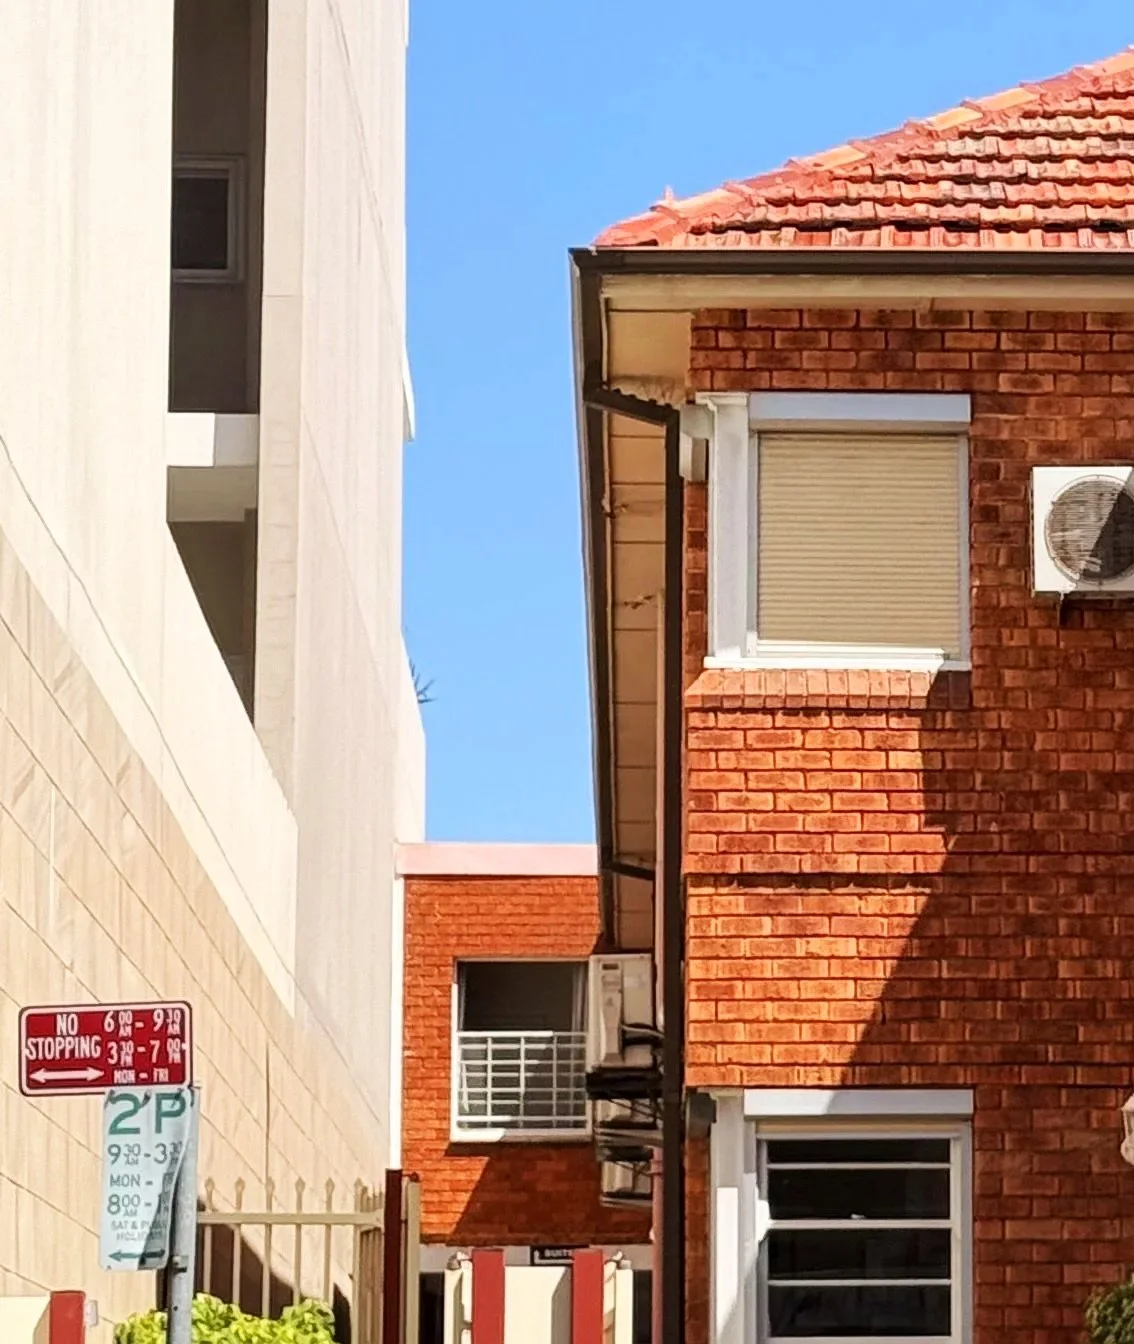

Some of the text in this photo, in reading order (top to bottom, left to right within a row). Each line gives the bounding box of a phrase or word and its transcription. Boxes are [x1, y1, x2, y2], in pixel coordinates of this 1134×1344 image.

[56, 1014, 78, 1036] NO
[27, 1035, 101, 1060] STOPPING
[113, 1069, 136, 1083] MON
[153, 1068, 169, 1082] FRI
[110, 1174, 140, 1187] MON
